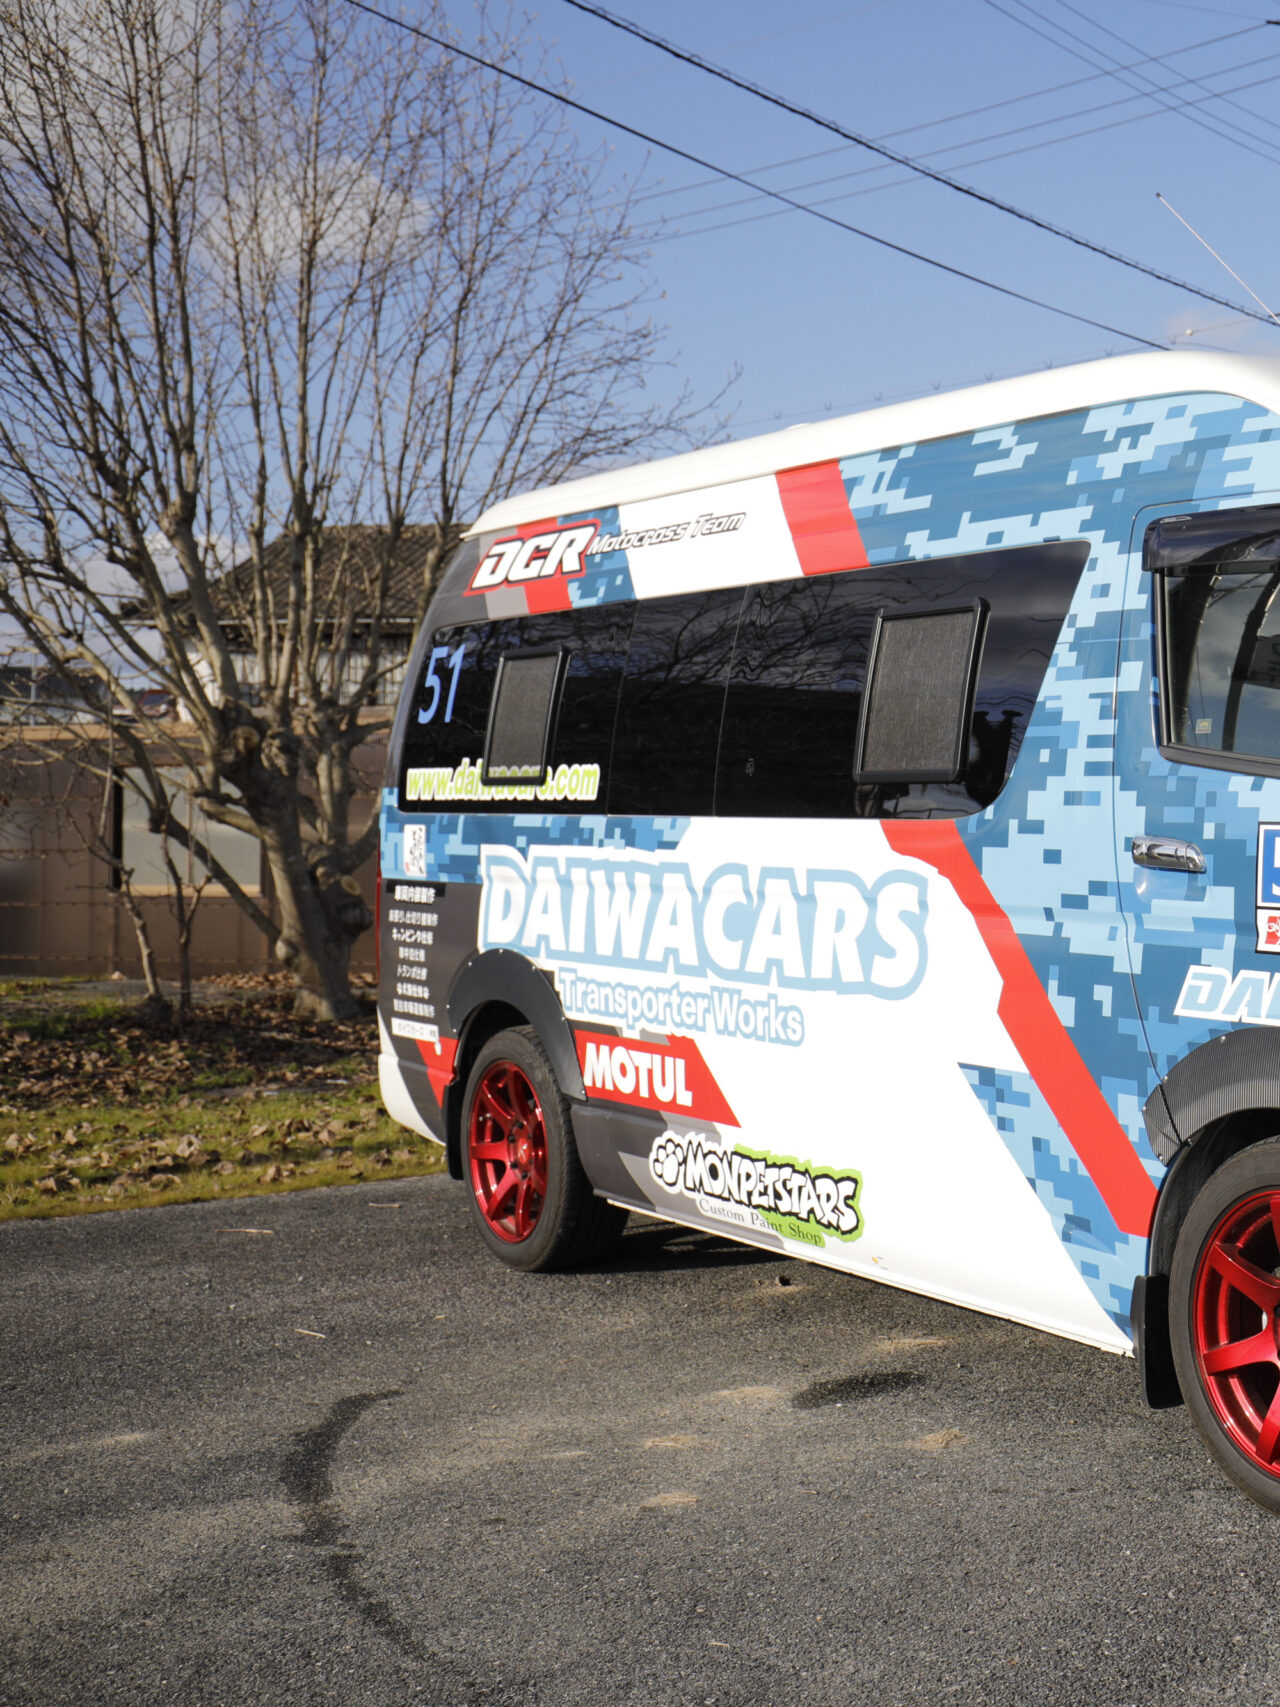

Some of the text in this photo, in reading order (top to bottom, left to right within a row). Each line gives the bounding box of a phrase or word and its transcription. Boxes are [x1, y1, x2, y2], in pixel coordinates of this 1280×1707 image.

[467, 512, 747, 592] DCR Motocross Team
[418, 643, 466, 724] 51
[484, 856, 928, 1000] DAIWACARS
[558, 967, 805, 1047] Transporter Works
[583, 1042, 693, 1107] MOTUL
[685, 1138, 861, 1235] MONPETSTARS
[699, 1198, 822, 1245] Custom Paint Shop
